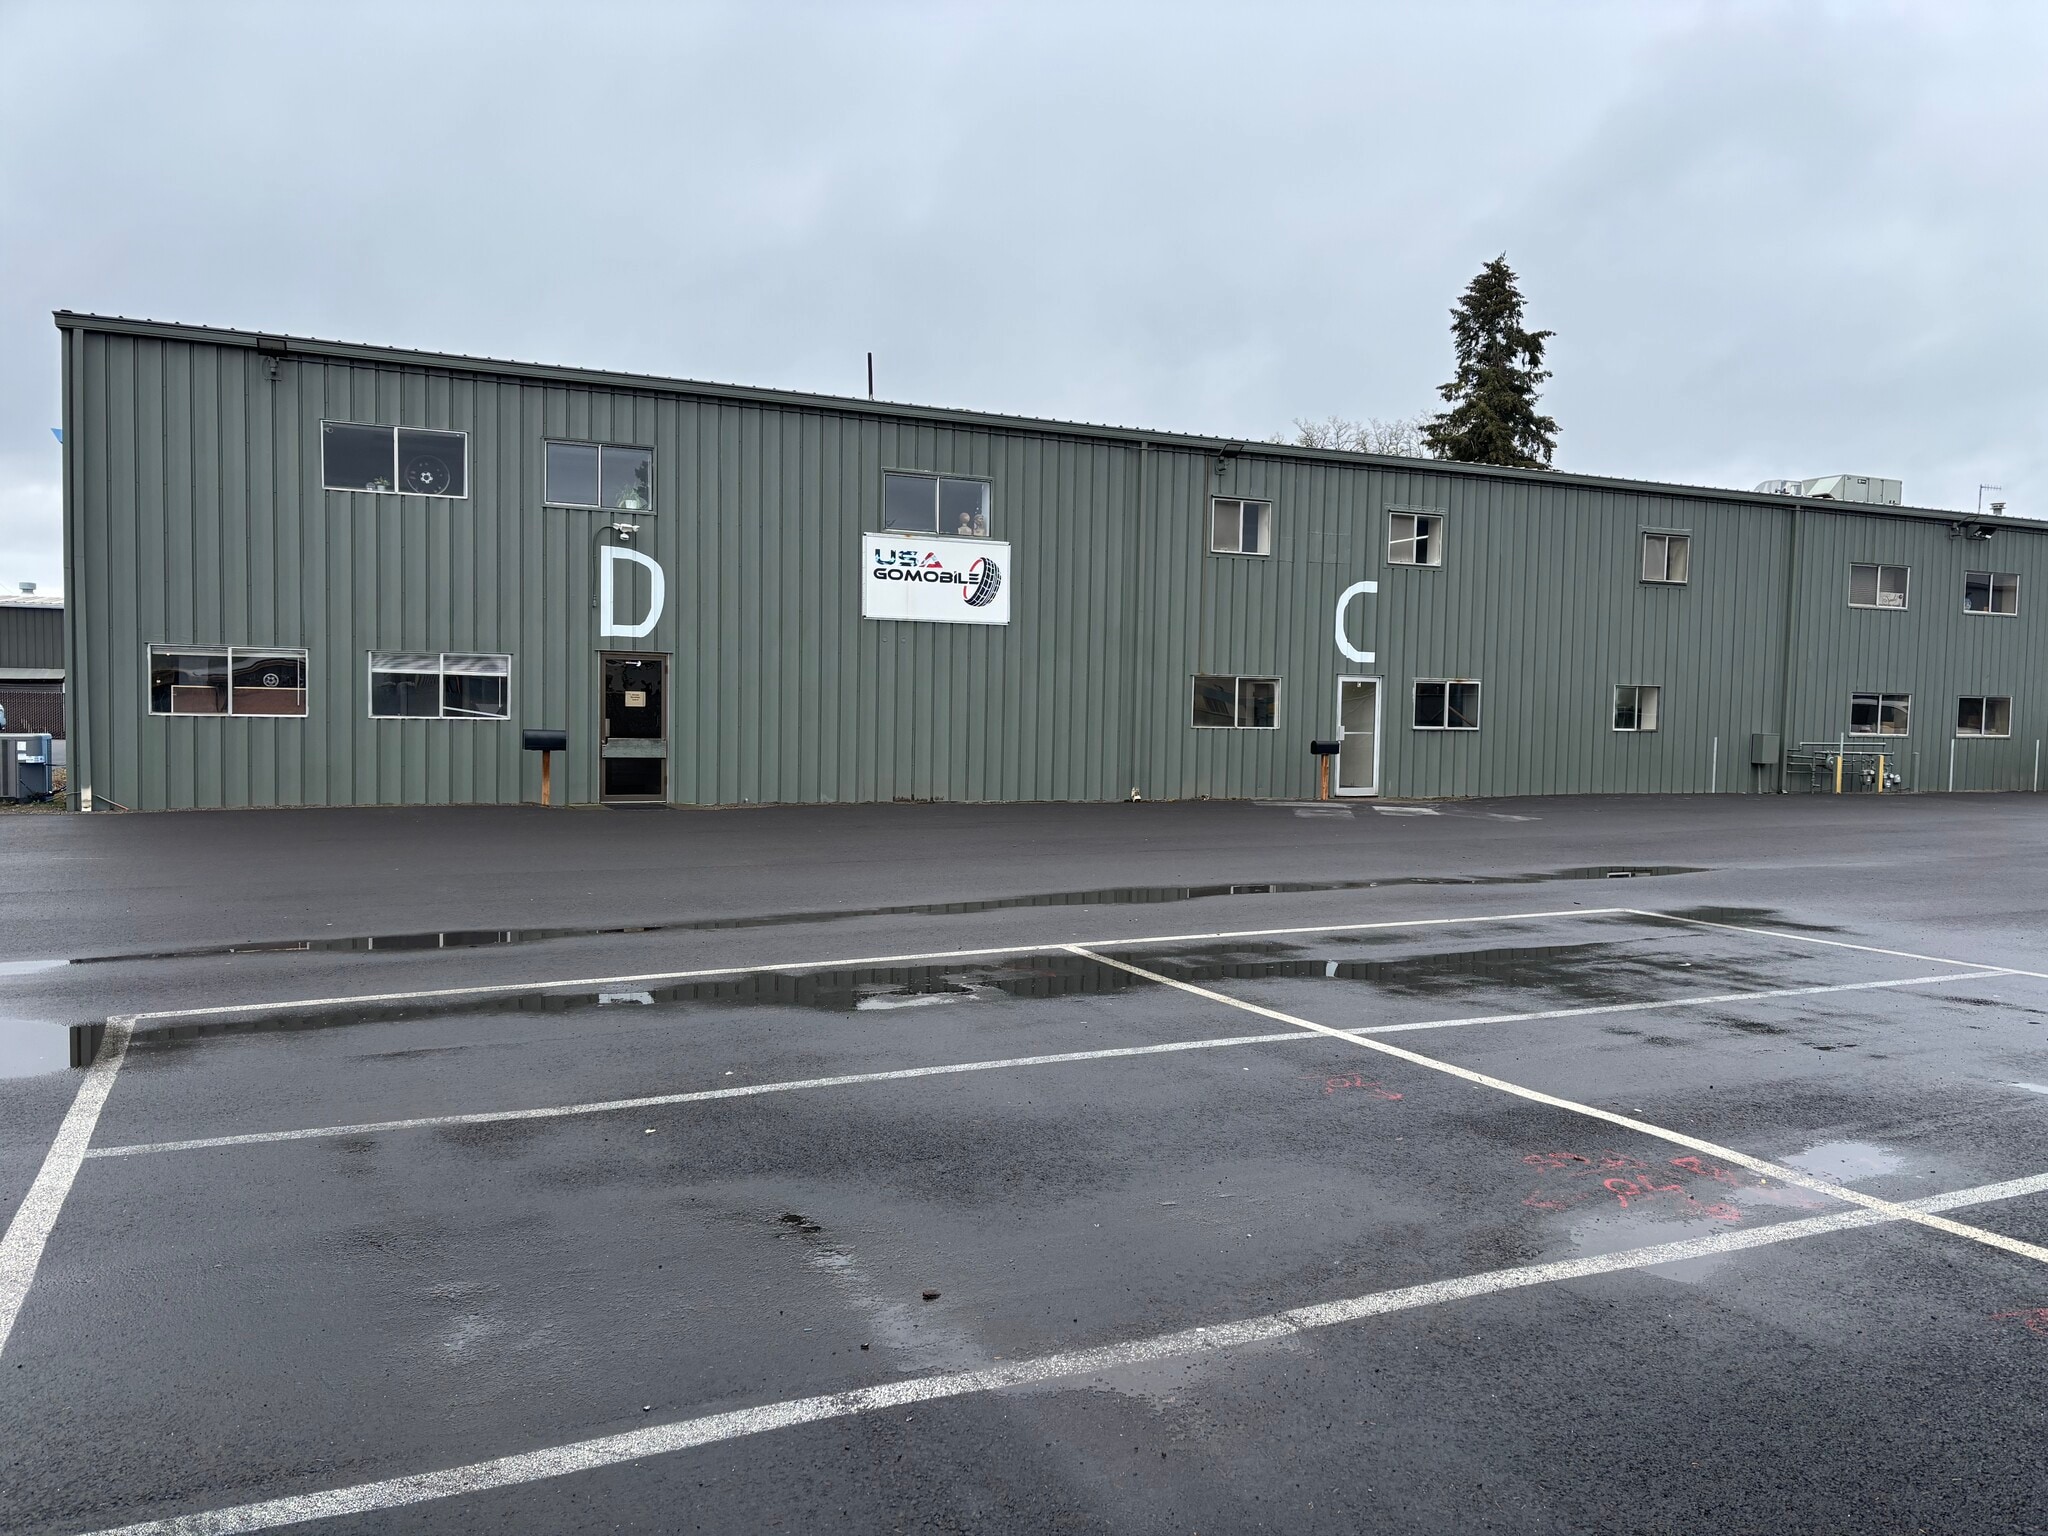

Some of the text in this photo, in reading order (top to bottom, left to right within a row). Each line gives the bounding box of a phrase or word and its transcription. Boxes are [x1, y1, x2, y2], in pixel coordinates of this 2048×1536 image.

[873, 568, 980, 585] GOMOBILE
[874, 548, 943, 568] USA
[600, 545, 665, 638] D
[1335, 581, 1378, 663] C
